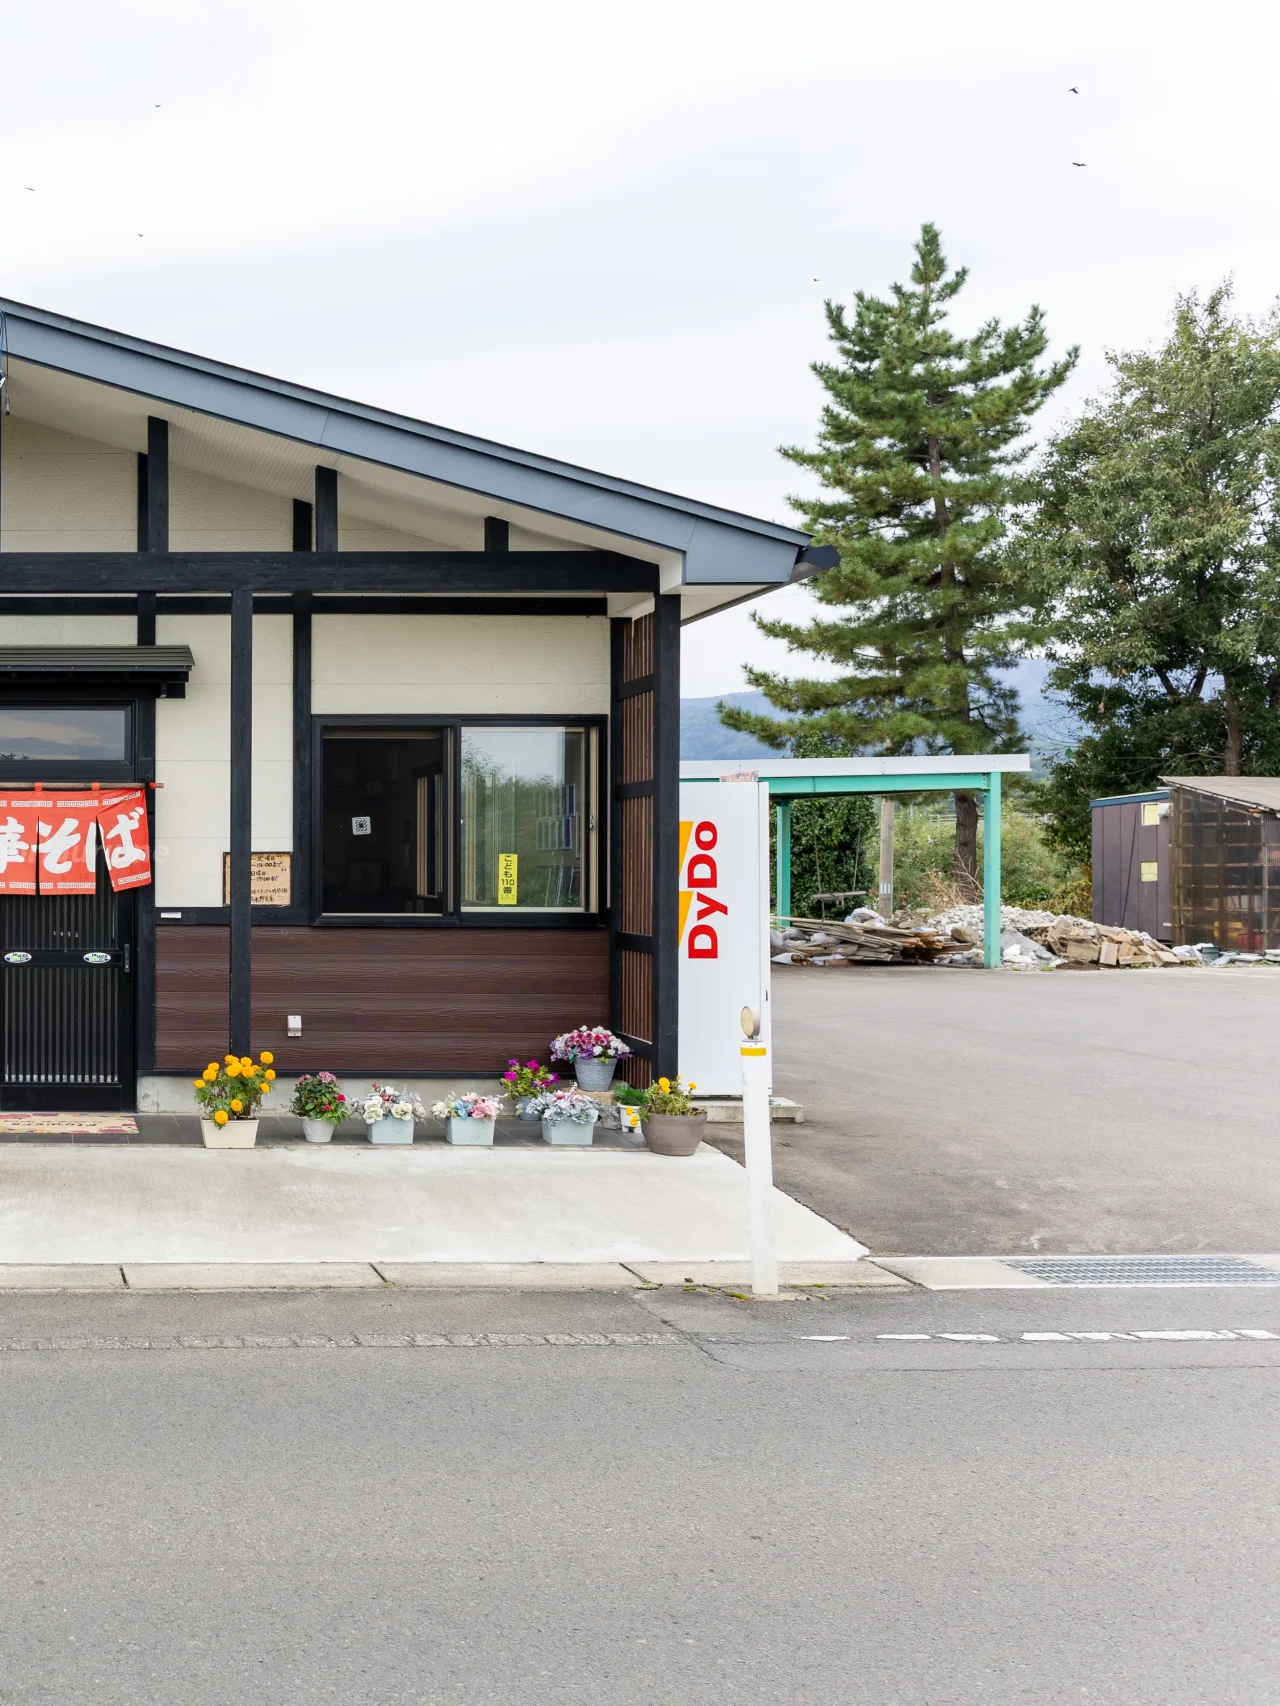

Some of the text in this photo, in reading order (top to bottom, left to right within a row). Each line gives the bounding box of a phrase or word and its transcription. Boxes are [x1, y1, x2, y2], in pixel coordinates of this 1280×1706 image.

[501, 855, 515, 895] こども110番
[687, 821, 728, 959] DyDo
